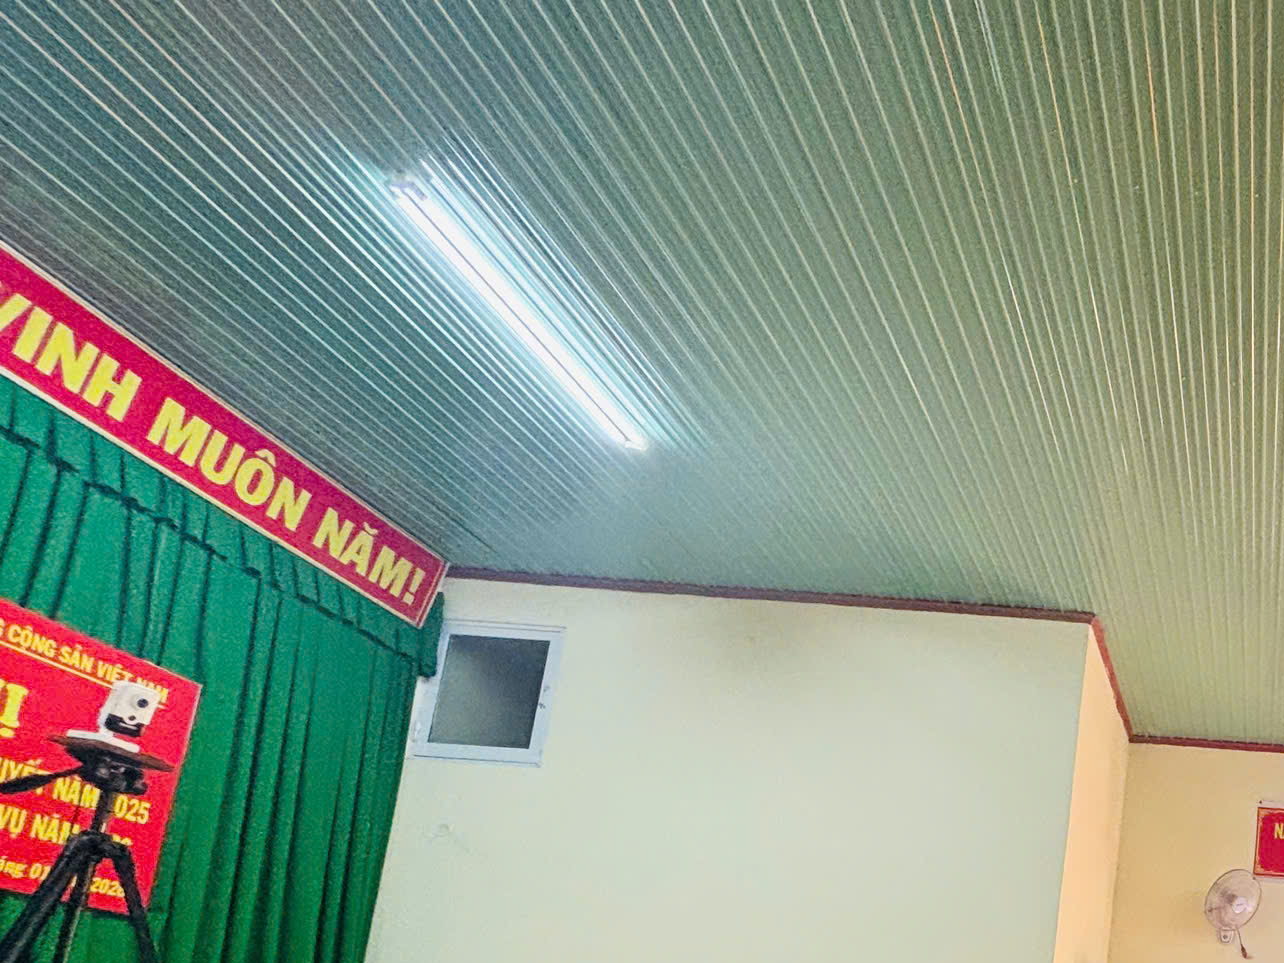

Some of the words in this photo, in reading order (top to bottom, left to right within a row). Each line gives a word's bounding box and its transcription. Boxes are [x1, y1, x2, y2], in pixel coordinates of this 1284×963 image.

[146, 397, 312, 532] MUÔN
[312, 507, 426, 606] NĂM!
[58, 644, 95, 673] SẢN
[113, 794, 151, 824] 025
